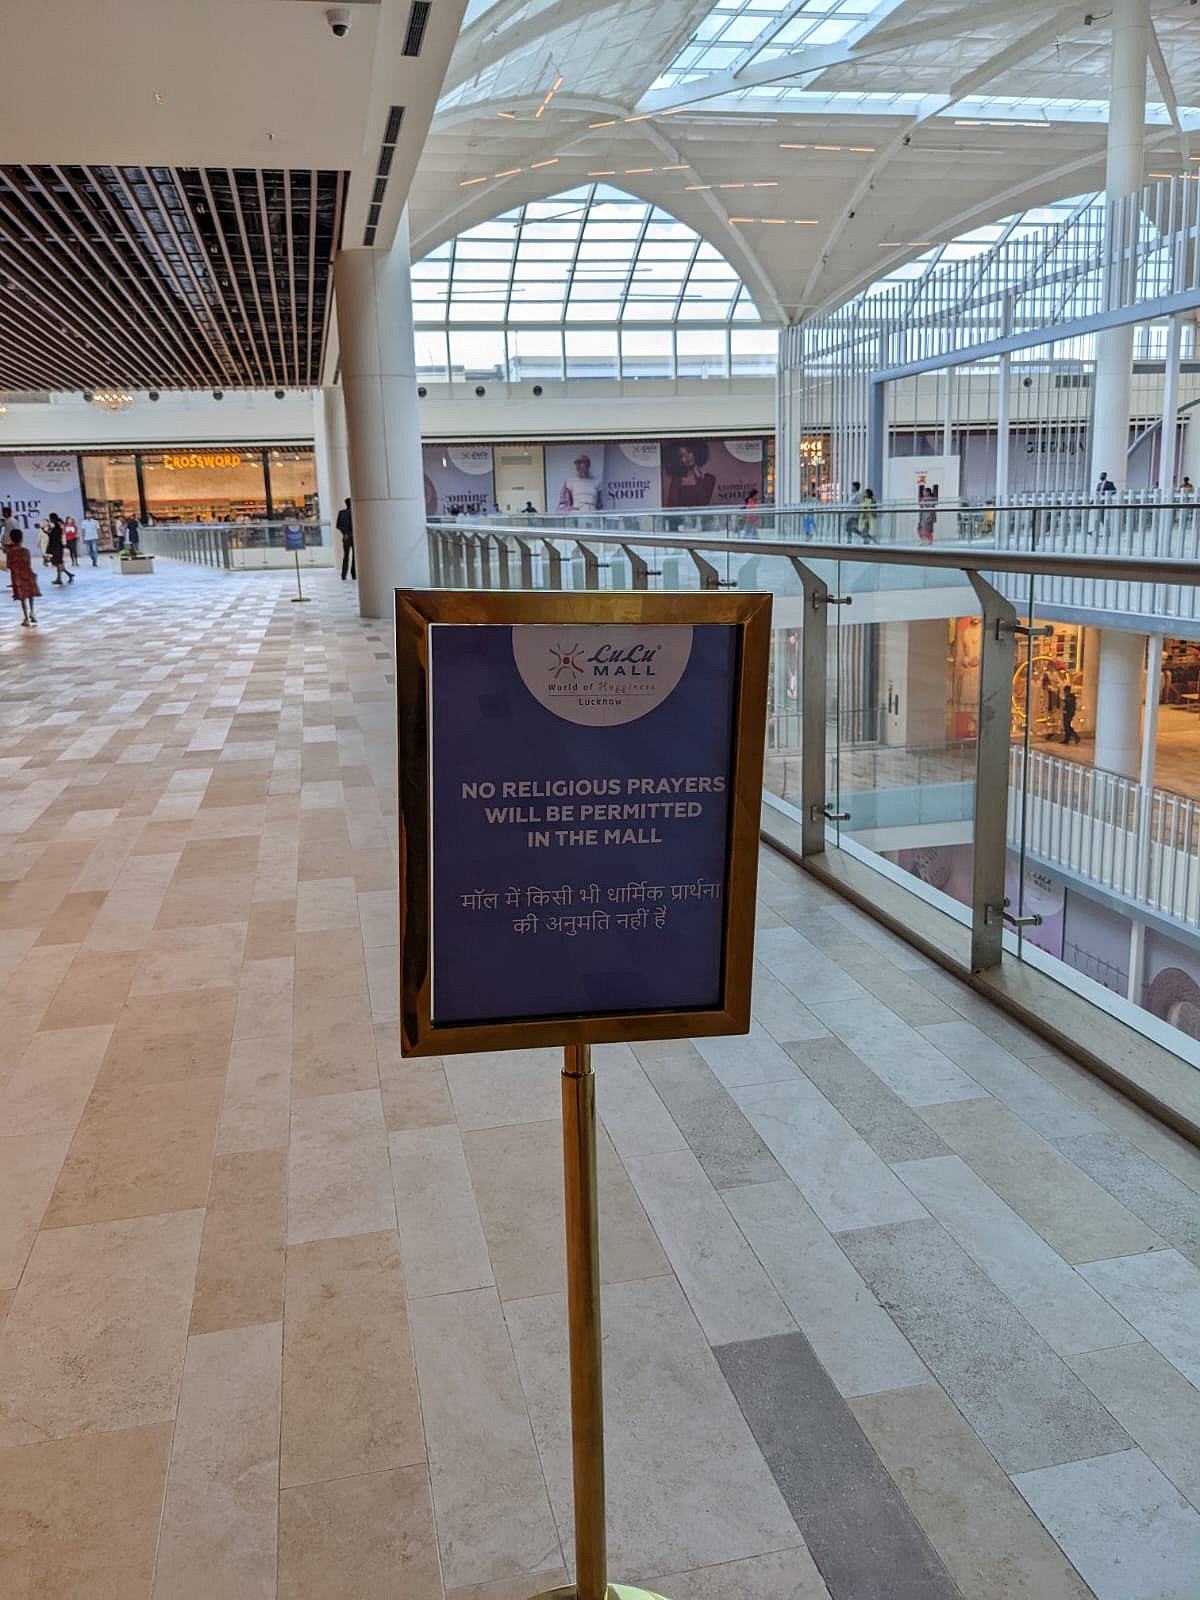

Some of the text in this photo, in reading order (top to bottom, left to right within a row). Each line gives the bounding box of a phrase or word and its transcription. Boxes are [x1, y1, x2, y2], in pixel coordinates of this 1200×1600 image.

[163, 455, 241, 468] CROSSWORD
[607, 476, 652, 490] coming
[587, 643, 658, 664] LuLu
[593, 665, 656, 676] MALL
[548, 681, 656, 694] World of Happiness
[578, 697, 623, 706] Lucknow
[461, 776, 726, 799] NO RELIGIOUS PRAYERS
[484, 802, 703, 824] WILL BE PERMITTED
[527, 828, 663, 848] IN THE MALL
[460, 878, 721, 910] मॉल में किसी भी धार्मिक प्रार्थना
[512, 905, 668, 936] की अनुमति नहीं है
